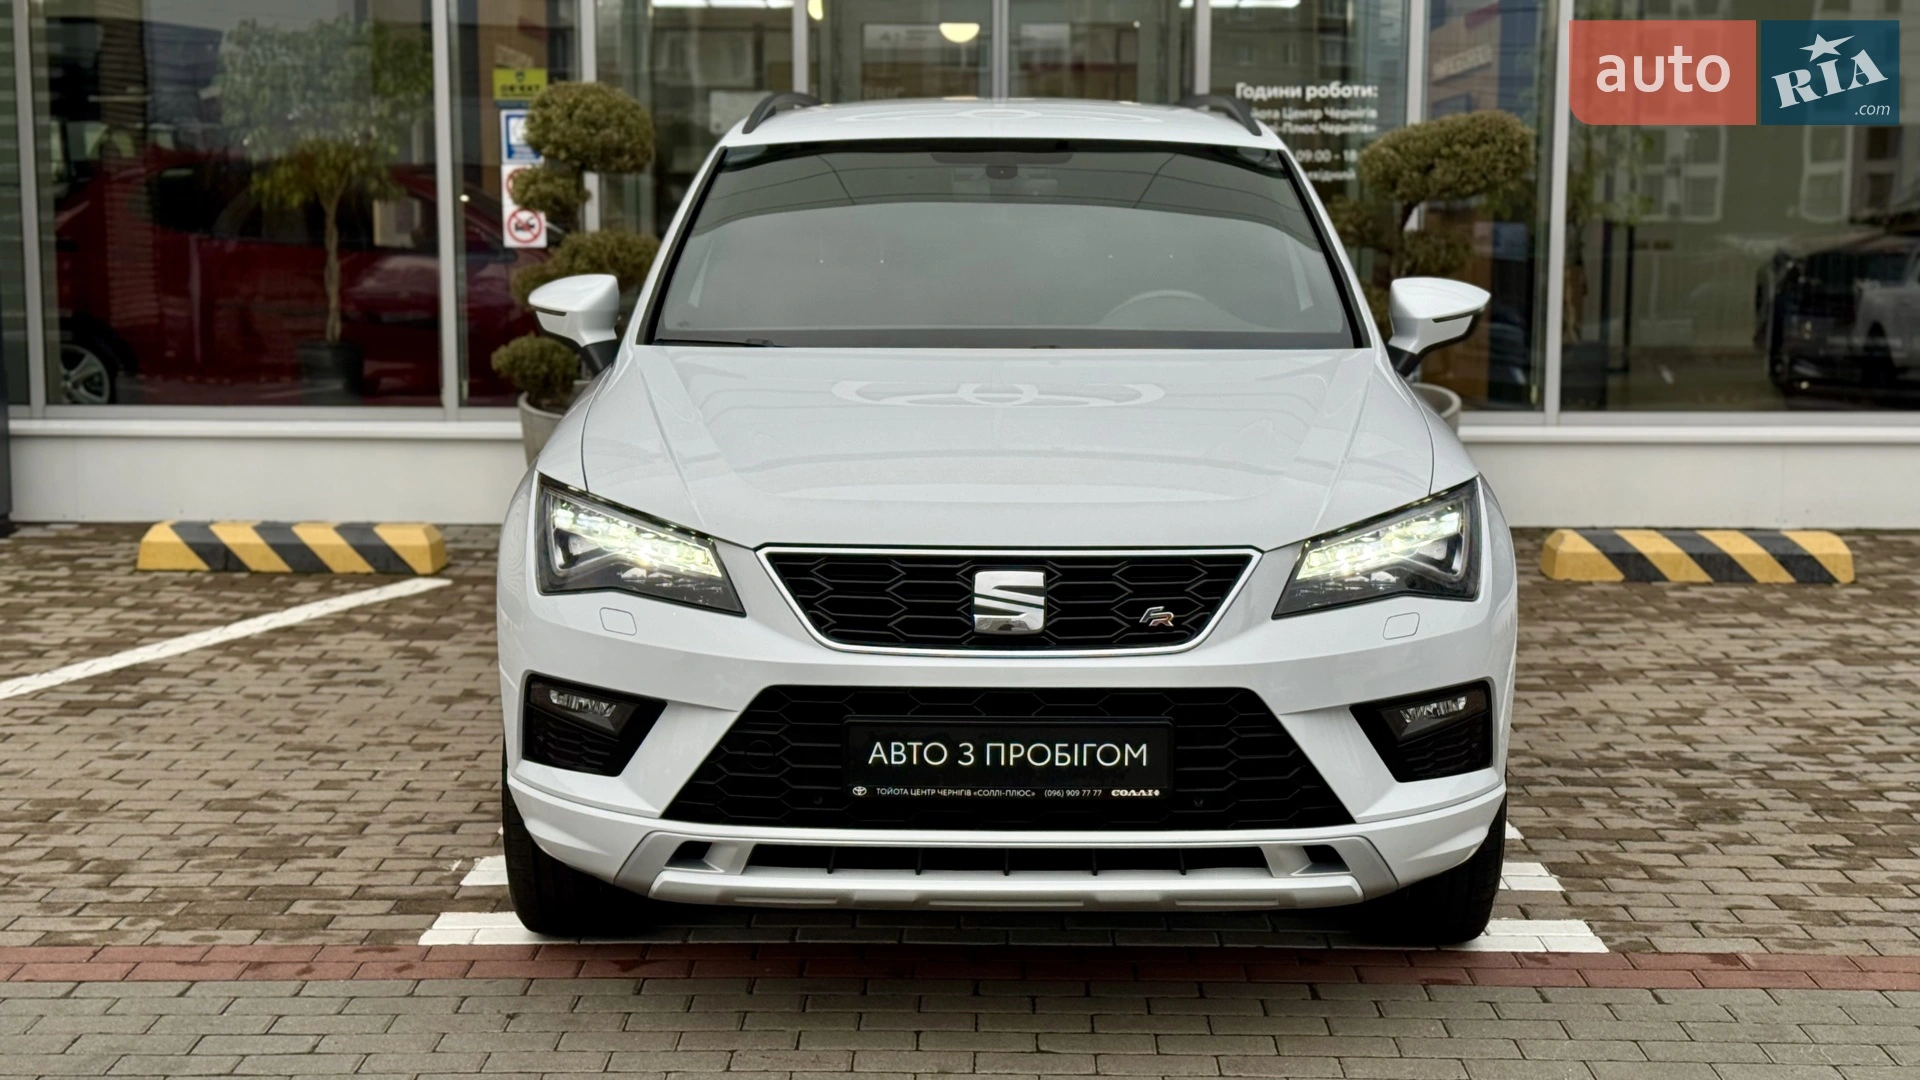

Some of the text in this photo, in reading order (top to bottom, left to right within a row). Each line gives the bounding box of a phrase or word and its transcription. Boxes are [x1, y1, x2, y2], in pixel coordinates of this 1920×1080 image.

[1236, 80, 1379, 102] Години роботи:
[1282, 107, 1323, 121] Центр
[1324, 106, 1378, 121] Чернігів
[868, 741, 948, 766] АВТО
[986, 743, 1148, 767] ПРОБІГОМ
[877, 787, 909, 796] ТОЙОТА
[910, 787, 936, 798] ЦЕНТР
[937, 788, 972, 797] ЧЕРНІГІВ
[1044, 788, 1102, 799] (096) 909 77 77
